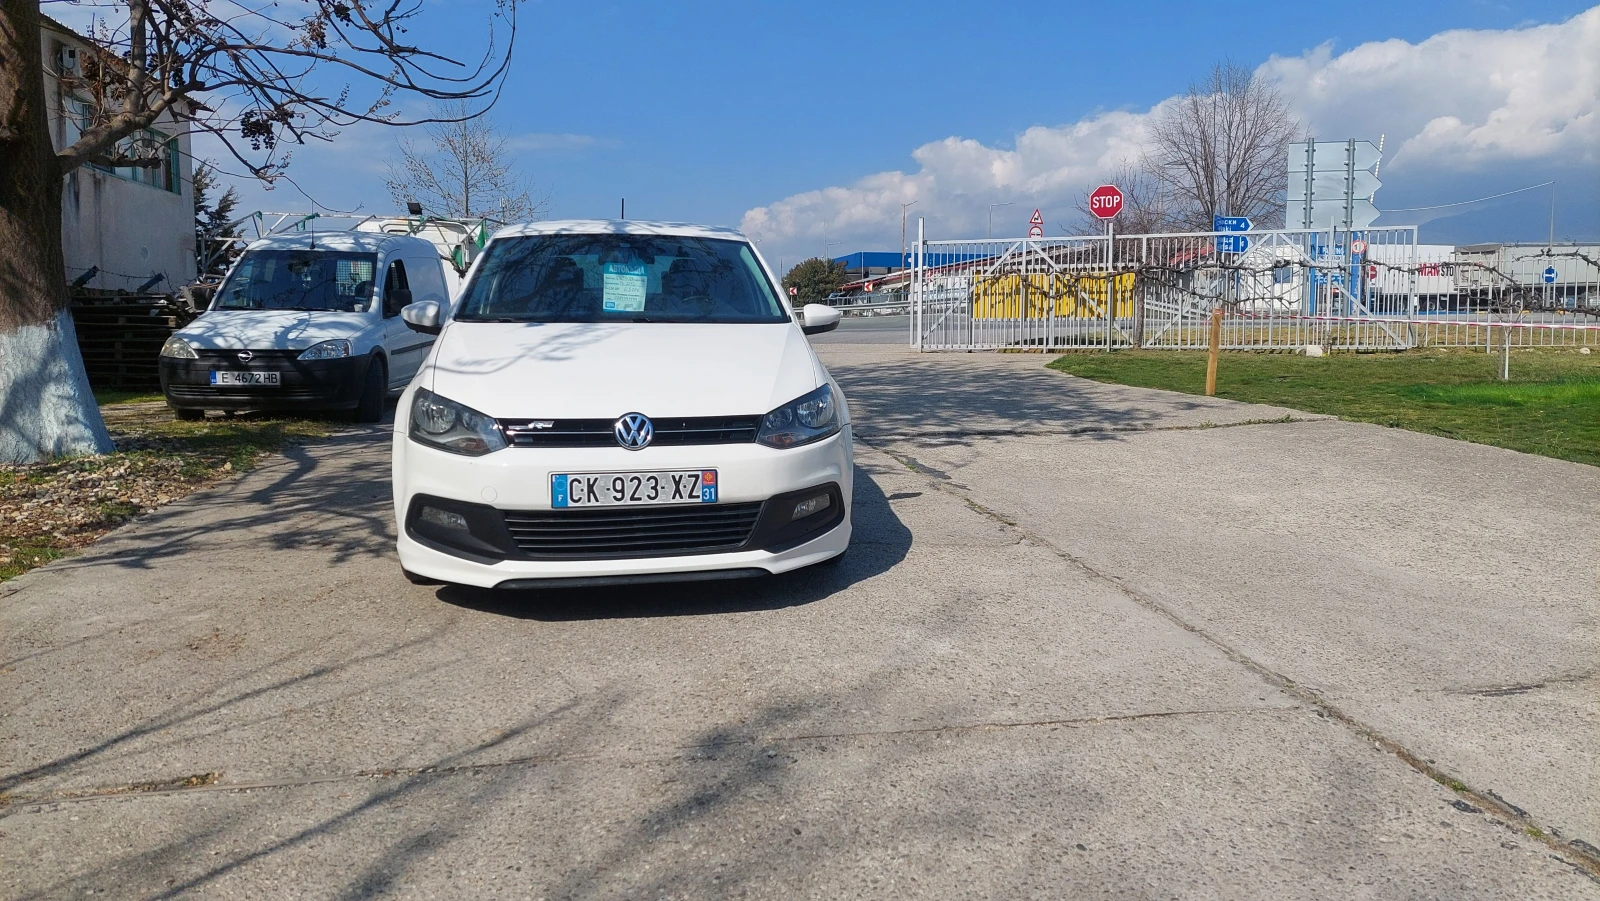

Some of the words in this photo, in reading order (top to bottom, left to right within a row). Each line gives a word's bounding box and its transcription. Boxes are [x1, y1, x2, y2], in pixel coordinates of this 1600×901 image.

[1093, 195, 1121, 209] STOP
[1419, 263, 1440, 277] MAN
[221, 372, 229, 383] E
[234, 372, 262, 384] 4672
[263, 373, 278, 384] HB
[557, 494, 564, 502] F
[703, 488, 715, 500] 31
